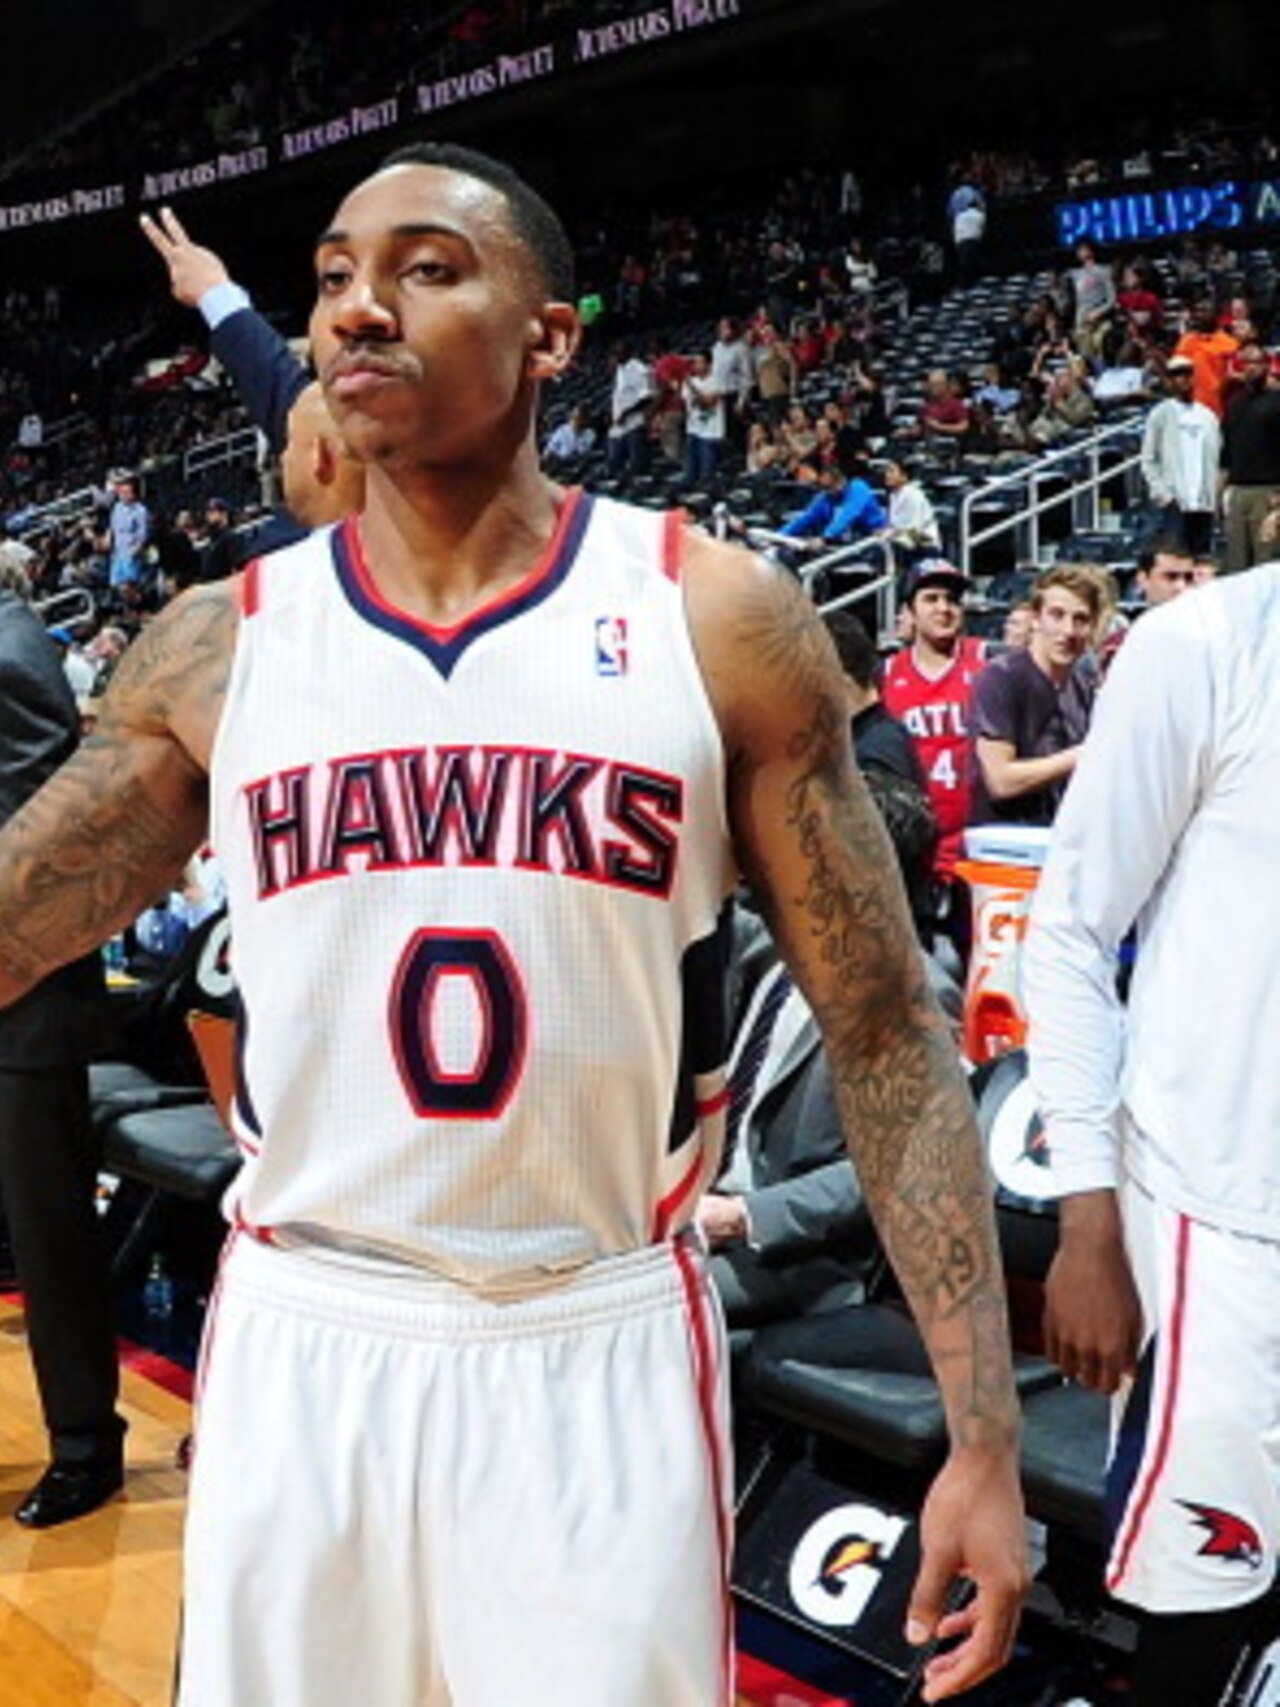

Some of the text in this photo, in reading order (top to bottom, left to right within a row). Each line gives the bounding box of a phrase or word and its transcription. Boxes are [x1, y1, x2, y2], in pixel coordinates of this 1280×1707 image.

[1059, 181, 1242, 245] PHILIPS
[902, 701, 969, 738] ATL
[928, 748, 957, 790] 4
[243, 744, 685, 901] HAWKS
[387, 926, 529, 1120] 0
[789, 1503, 910, 1627] G
